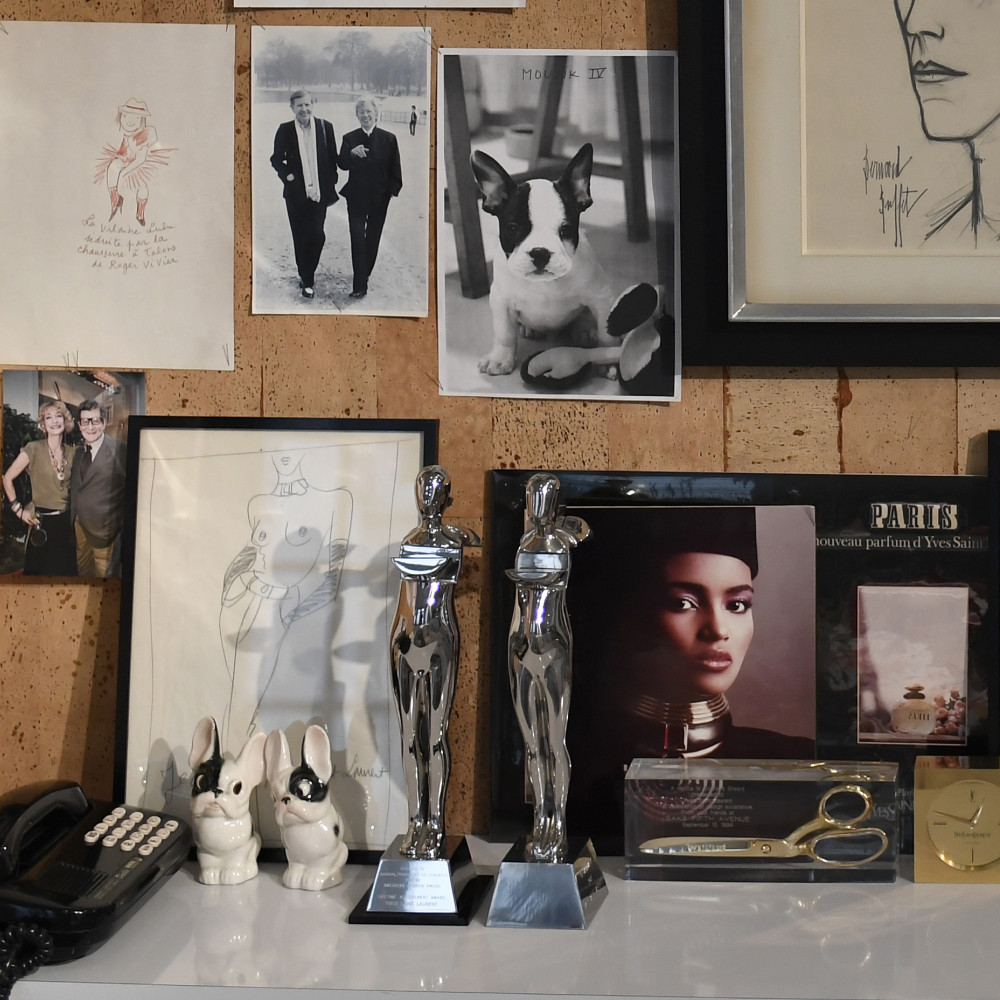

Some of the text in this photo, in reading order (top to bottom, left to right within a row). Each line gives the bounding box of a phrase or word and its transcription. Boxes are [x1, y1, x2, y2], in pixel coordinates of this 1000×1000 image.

[588, 67, 607, 80] IV
[108, 259, 139, 276] Roger
[870, 502, 958, 530] PARIS
[866, 535, 911, 550] parfum
